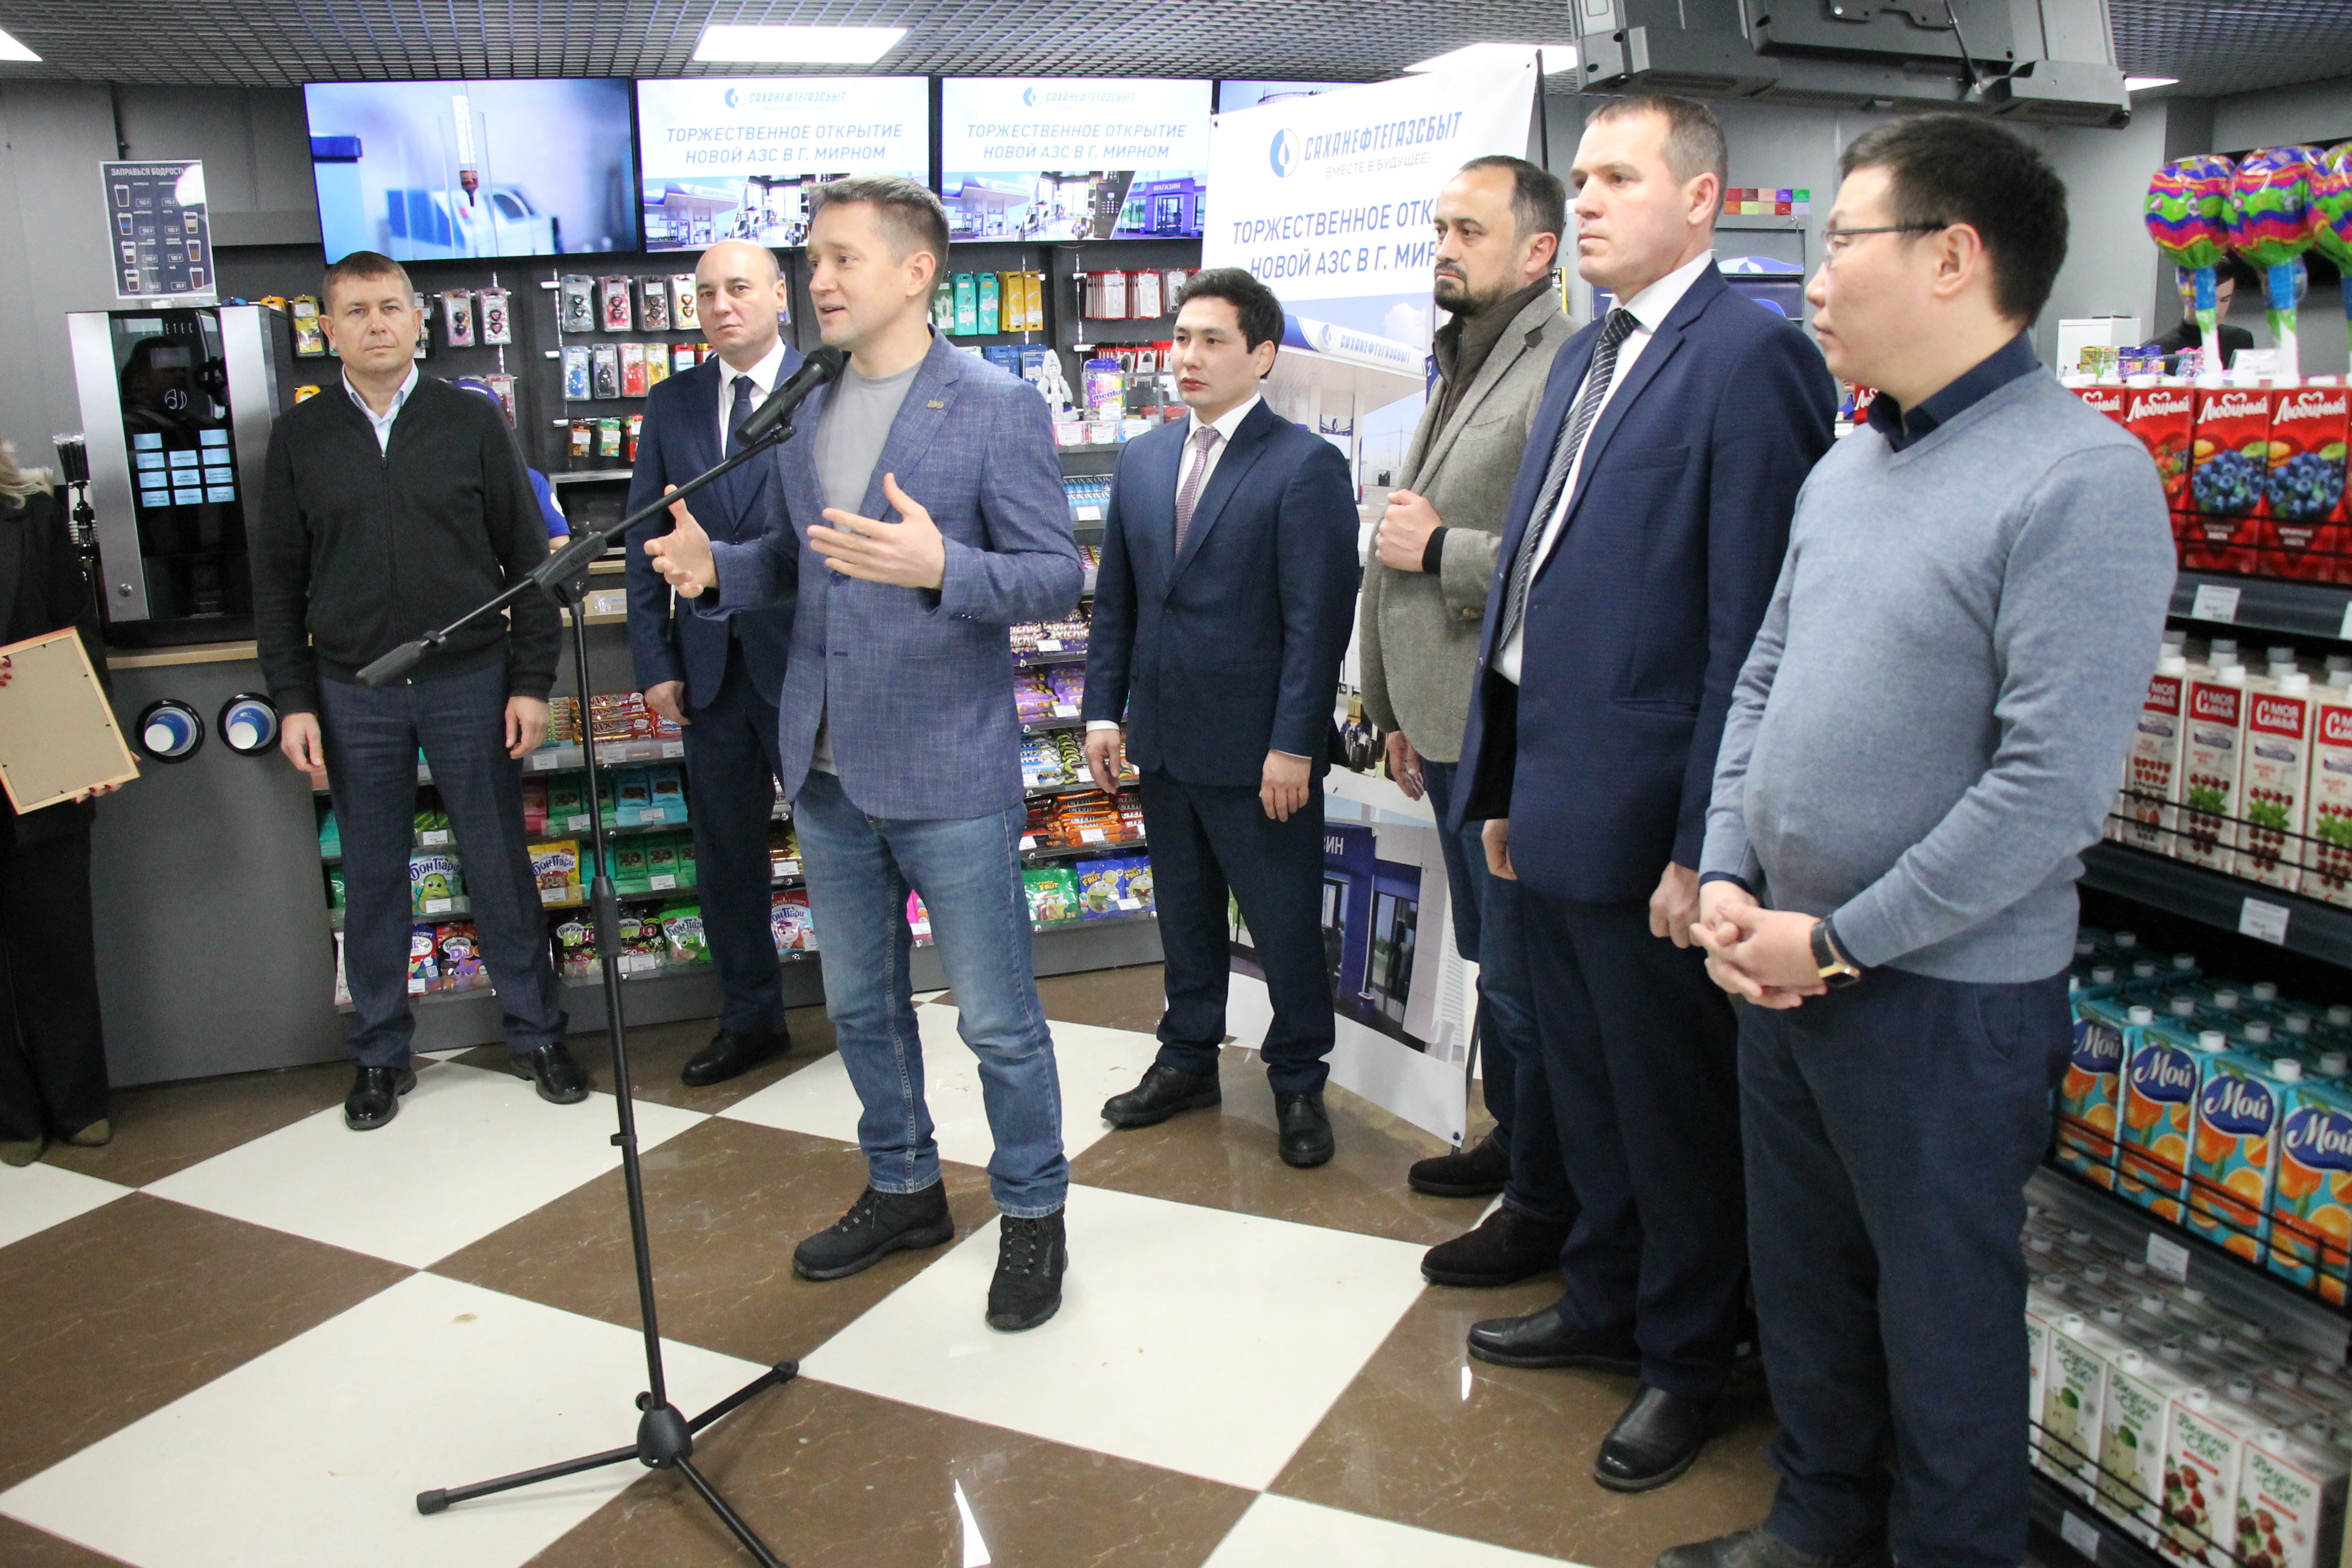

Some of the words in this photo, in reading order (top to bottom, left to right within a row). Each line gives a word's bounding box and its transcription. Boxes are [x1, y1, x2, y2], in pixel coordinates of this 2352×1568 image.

[749, 91, 846, 103] САХАНЕФТЕГАЗСБЫТ
[1046, 92, 1136, 102] САХАНЕФТЕГАЗСБЫТ
[667, 125, 810, 143] ТОРЖЕСТВЕННОЕ
[815, 124, 903, 139] ОТКРЫТИЕ
[967, 124, 1102, 138] ТОРЖЕСТВЕННОЕ
[1106, 124, 1187, 138] ОТКРЫТИЕ
[1304, 110, 1462, 161] САХАНЕФТЕГАЗСБЫТ
[686, 146, 743, 164] НОВОЙ
[746, 148, 778, 163] АЗС
[783, 148, 793, 162] В
[798, 148, 809, 161] Г.
[815, 146, 885, 161] МИРНОМ
[983, 143, 1037, 159] НОВОЙ
[1040, 145, 1070, 159] АЗС
[1075, 145, 1082, 159] В
[1088, 145, 1098, 159] Г.
[1103, 145, 1169, 159] МИРНОМ
[1325, 161, 1364, 177] ВМЕСТЕ
[1366, 161, 1375, 172] В
[1376, 151, 1430, 171] БУДУЩЕЕ!
[111, 167, 150, 176] ЗАПРАВЬСЯ
[1153, 182, 1181, 191] МАГАЗИН
[1233, 204, 1390, 245] ТОРЖЕСТВЕННОЕ
[1396, 198, 1440, 226] ОТК
[1250, 248, 1311, 280] НОВОЙ
[1316, 249, 1351, 275] АЗС
[1357, 250, 1368, 271] В
[1374, 246, 1387, 270] Г.
[1396, 241, 1435, 268] МИР
[1340, 334, 1412, 364] САХАНЕФТЕГАЗСБЫТ
[1093, 389, 1124, 402] mentos
[2126, 391, 2190, 423] Любимый
[2197, 392, 2268, 424] Любимый
[2273, 391, 2346, 426] Любимый
[1082, 873, 1101, 886] FRUT
[686, 919, 702, 930] Пар
[2073, 1026, 2120, 1059] Мой
[2133, 1052, 2191, 1090] Мой
[2204, 1080, 2269, 1122] Мой
[2286, 1114, 2352, 1155] Мой
